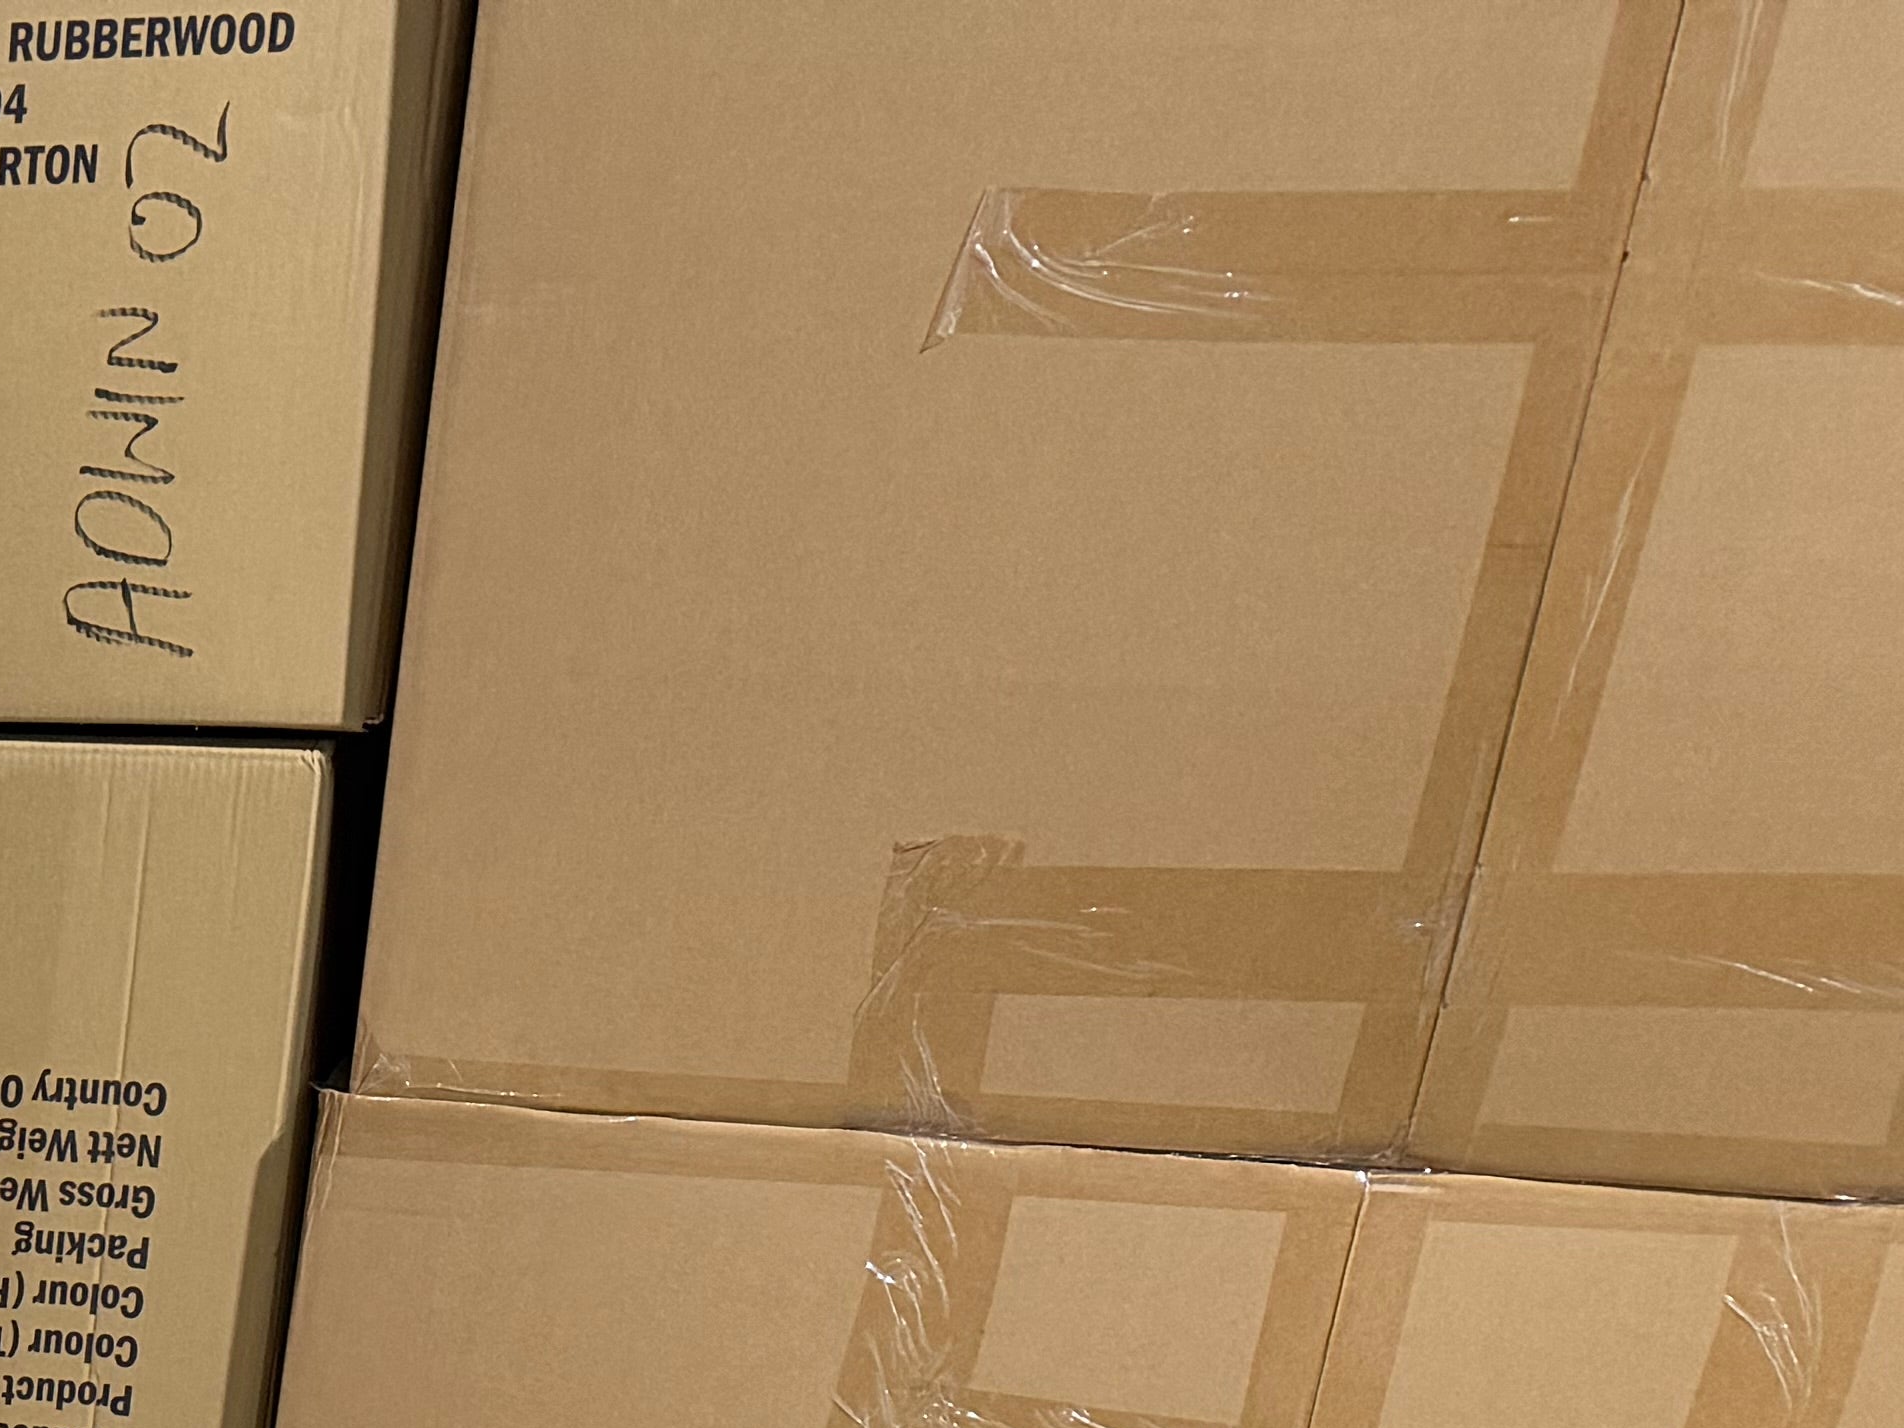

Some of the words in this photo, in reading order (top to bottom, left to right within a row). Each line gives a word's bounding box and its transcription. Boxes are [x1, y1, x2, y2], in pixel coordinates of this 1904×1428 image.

[8, 11, 295, 63] RUBBERWOOD
[31, 1068, 167, 1117] Country
[11, 1220, 150, 1270] Packing
[1, 1375, 133, 1417] Product
